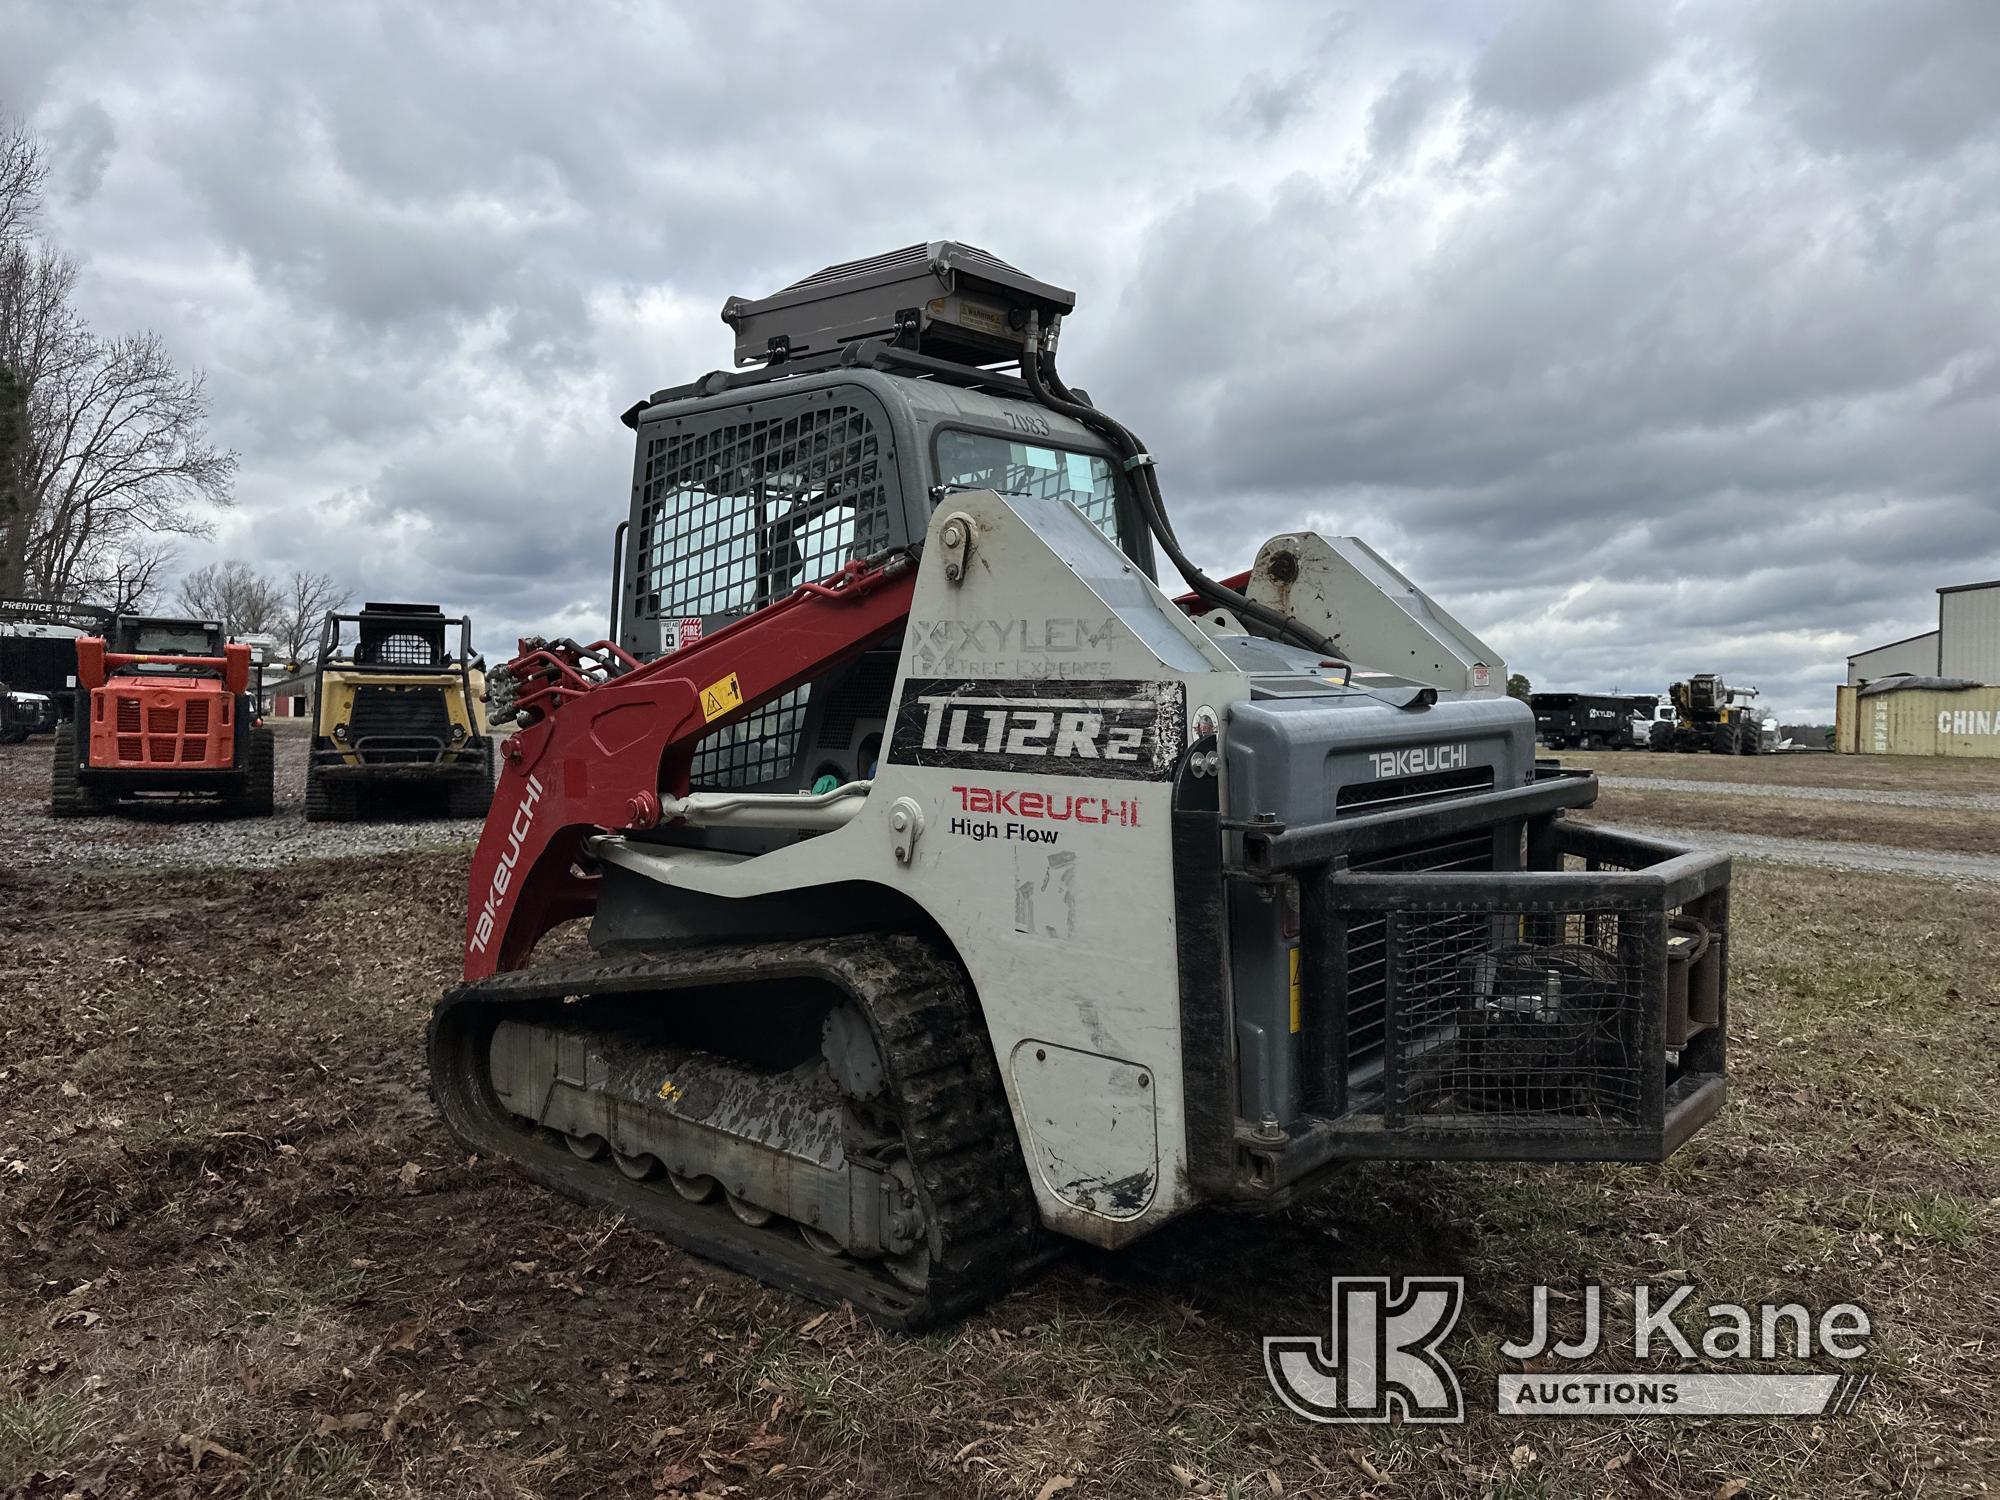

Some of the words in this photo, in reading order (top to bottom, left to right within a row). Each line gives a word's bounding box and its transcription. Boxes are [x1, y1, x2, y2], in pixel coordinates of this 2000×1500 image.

[1003, 411, 1050, 437] 7083
[1, 601, 53, 612] PRENTICE
[683, 625, 698, 636] FIRE
[1369, 744, 1467, 779] TAKEUCHI
[952, 785, 1141, 828] TAKEUCHI
[951, 818, 998, 842] High
[1006, 823, 1059, 844] Flow
[469, 774, 544, 954] TAKEUCHI
